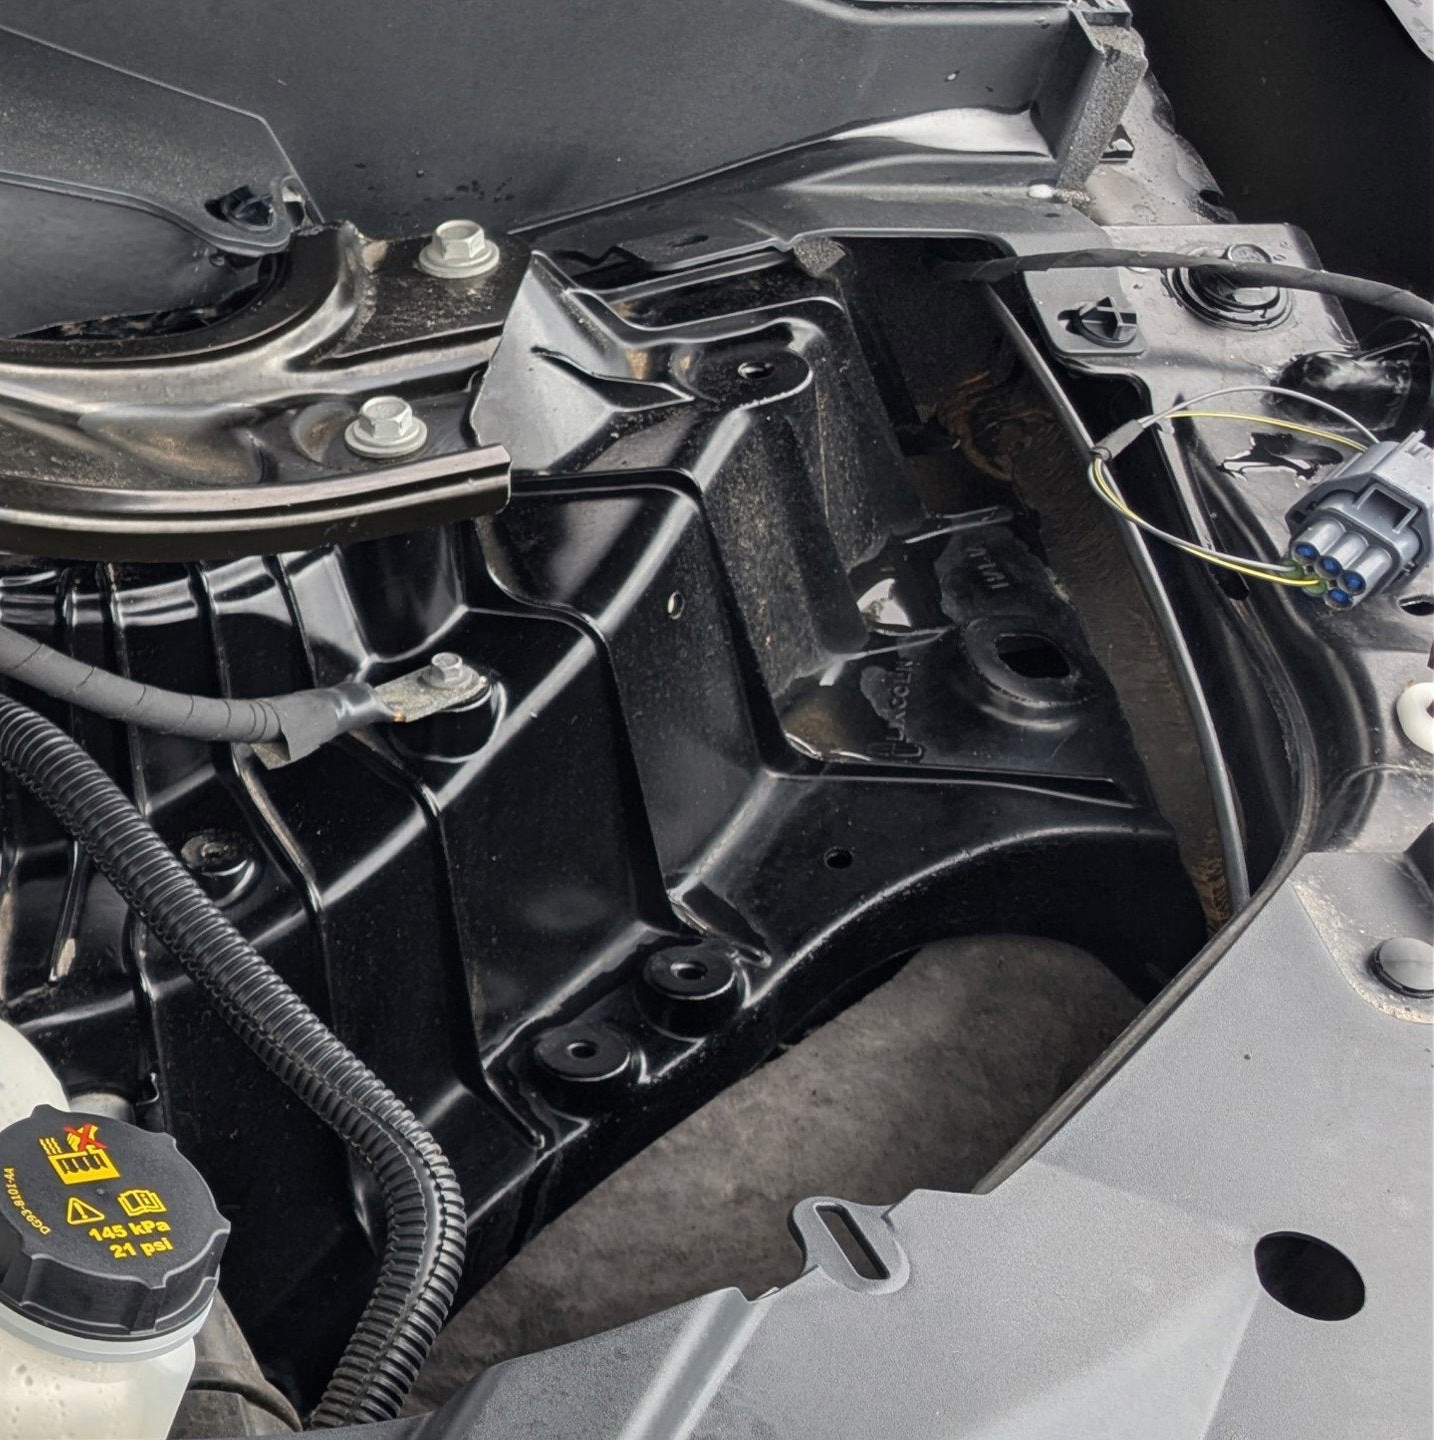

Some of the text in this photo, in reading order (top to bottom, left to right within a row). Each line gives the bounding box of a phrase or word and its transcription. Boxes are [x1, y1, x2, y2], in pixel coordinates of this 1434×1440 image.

[89, 1219, 171, 1242] 145 kPa
[109, 1237, 173, 1258] 21 psi
